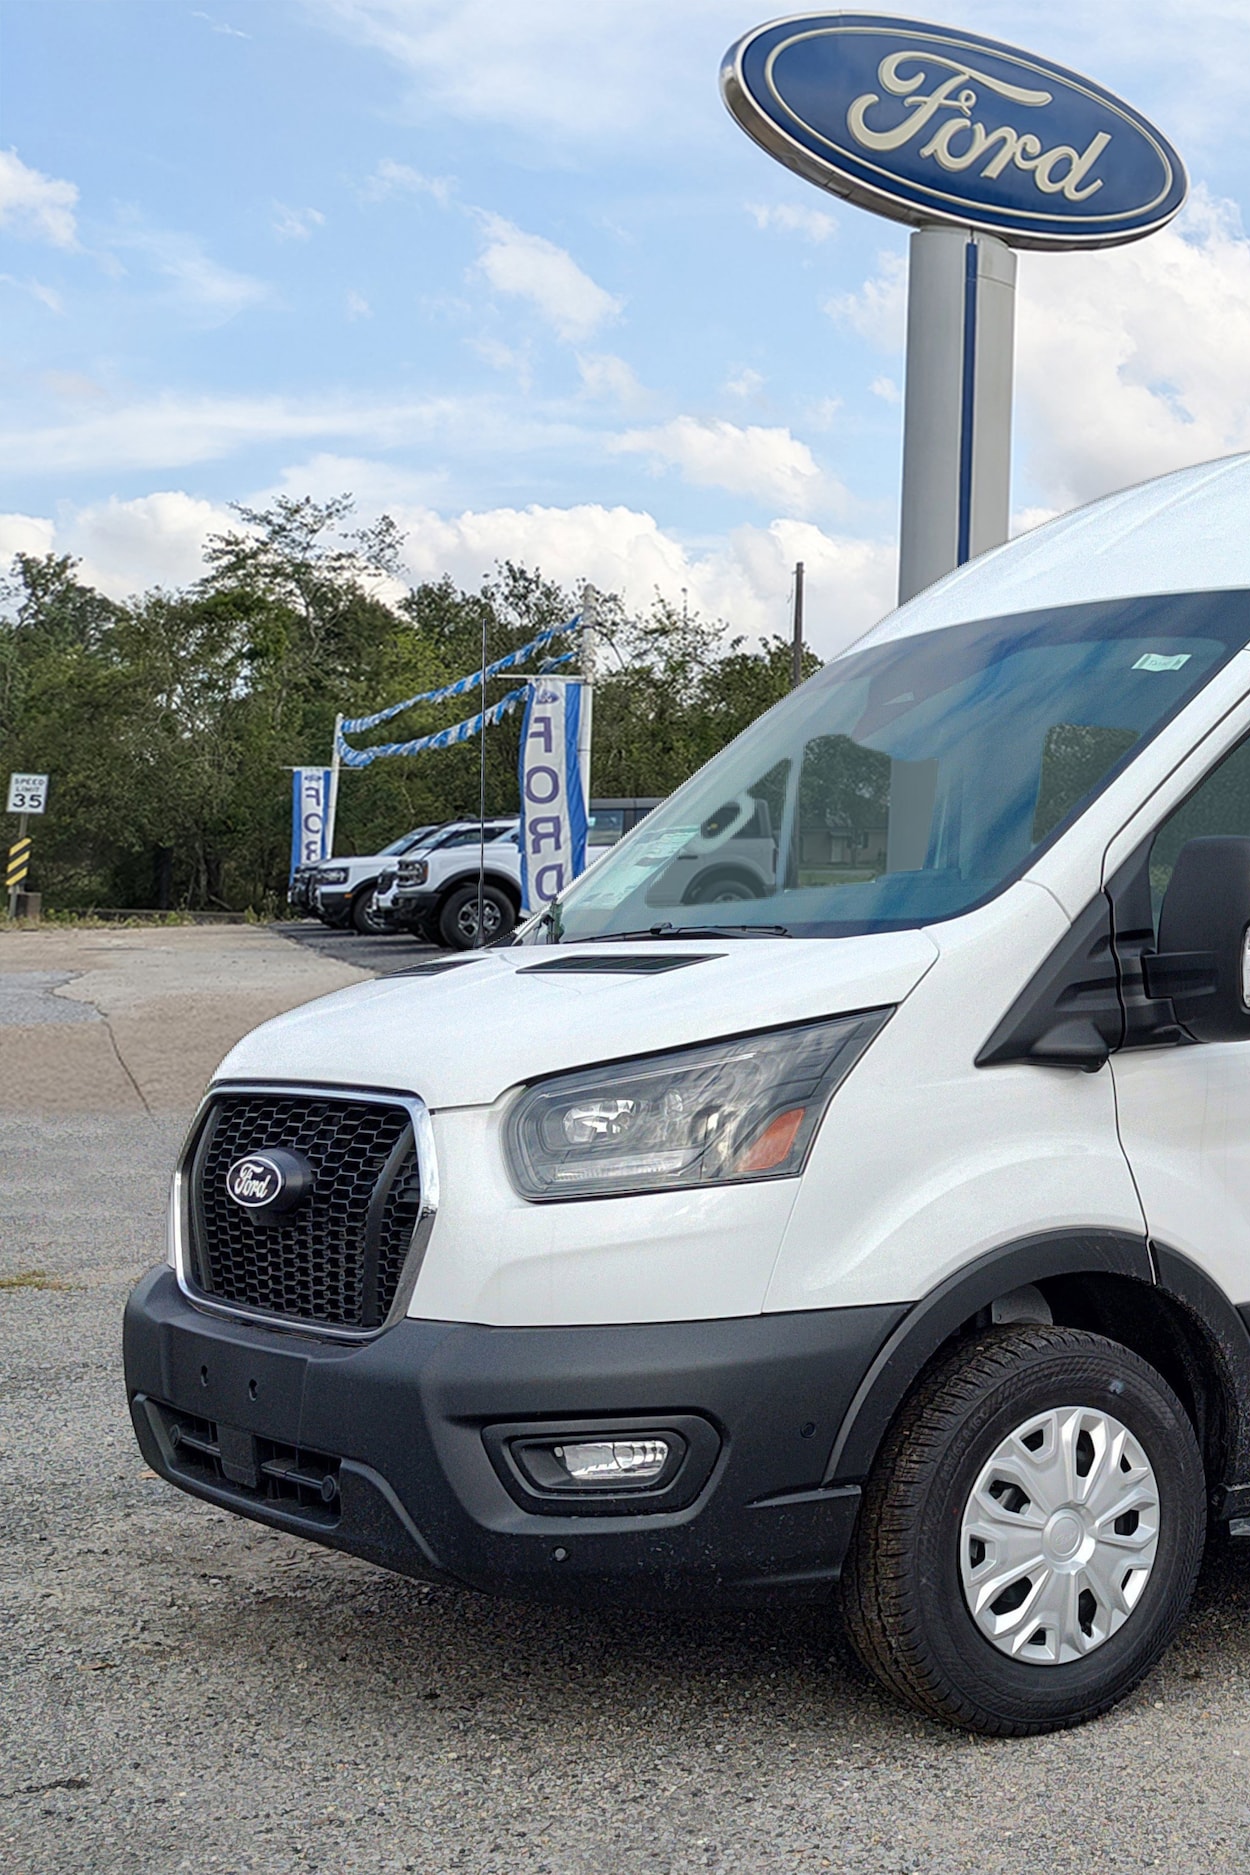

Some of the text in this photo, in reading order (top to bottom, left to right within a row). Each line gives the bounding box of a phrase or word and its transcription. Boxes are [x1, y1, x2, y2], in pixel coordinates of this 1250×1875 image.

[847, 50, 1112, 202] Ford
[15, 778, 45, 786] SPEED
[13, 793, 42, 809] 35
[234, 1163, 271, 1198] Ford
